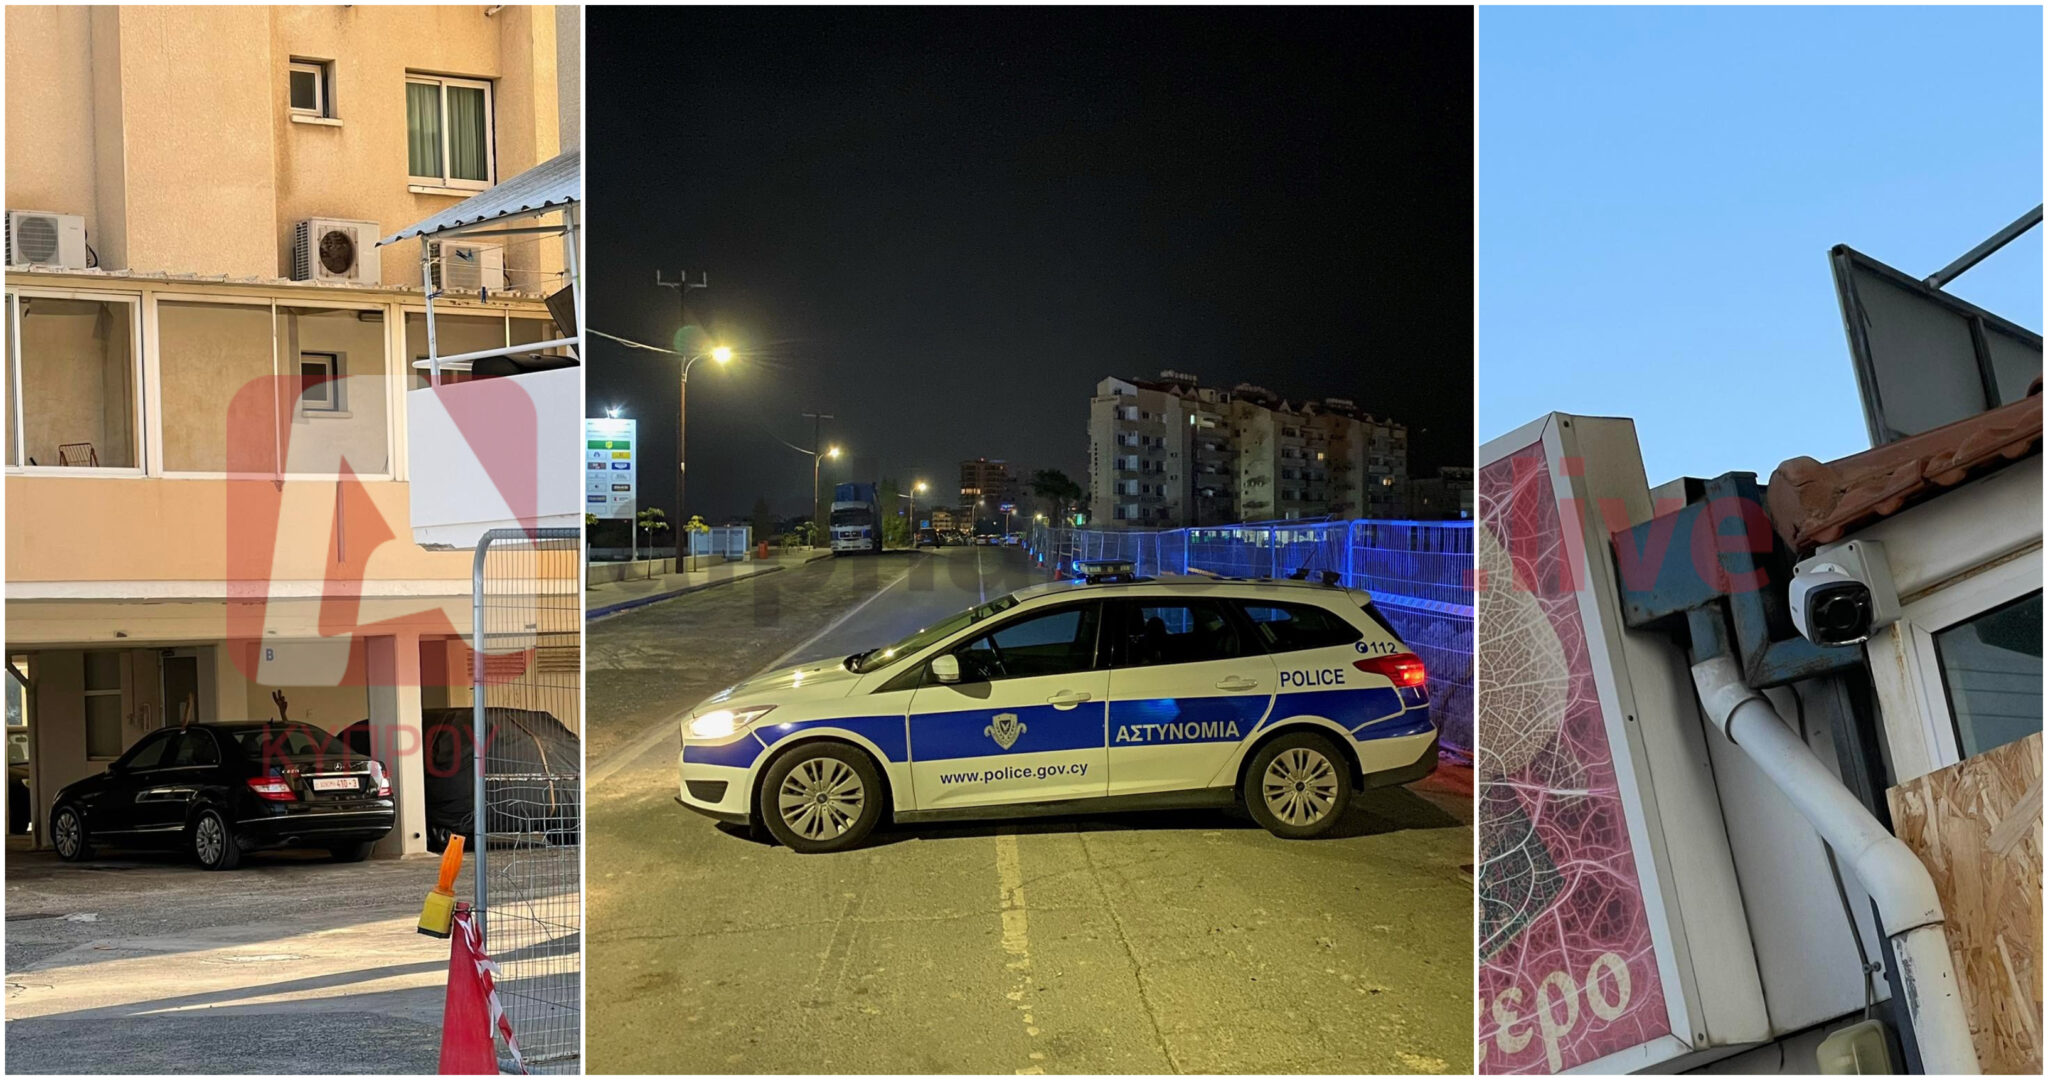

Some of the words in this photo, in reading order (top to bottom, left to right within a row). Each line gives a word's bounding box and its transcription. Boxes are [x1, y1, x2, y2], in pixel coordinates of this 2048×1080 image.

[1370, 641, 1398, 654] 112
[1279, 668, 1345, 688] POLICE
[1115, 720, 1240, 743] ΑΣΤΥΝΟΜΙΑ
[939, 762, 1088, 784] www.police.gov.cy
[1479, 952, 1631, 1075] ερο
